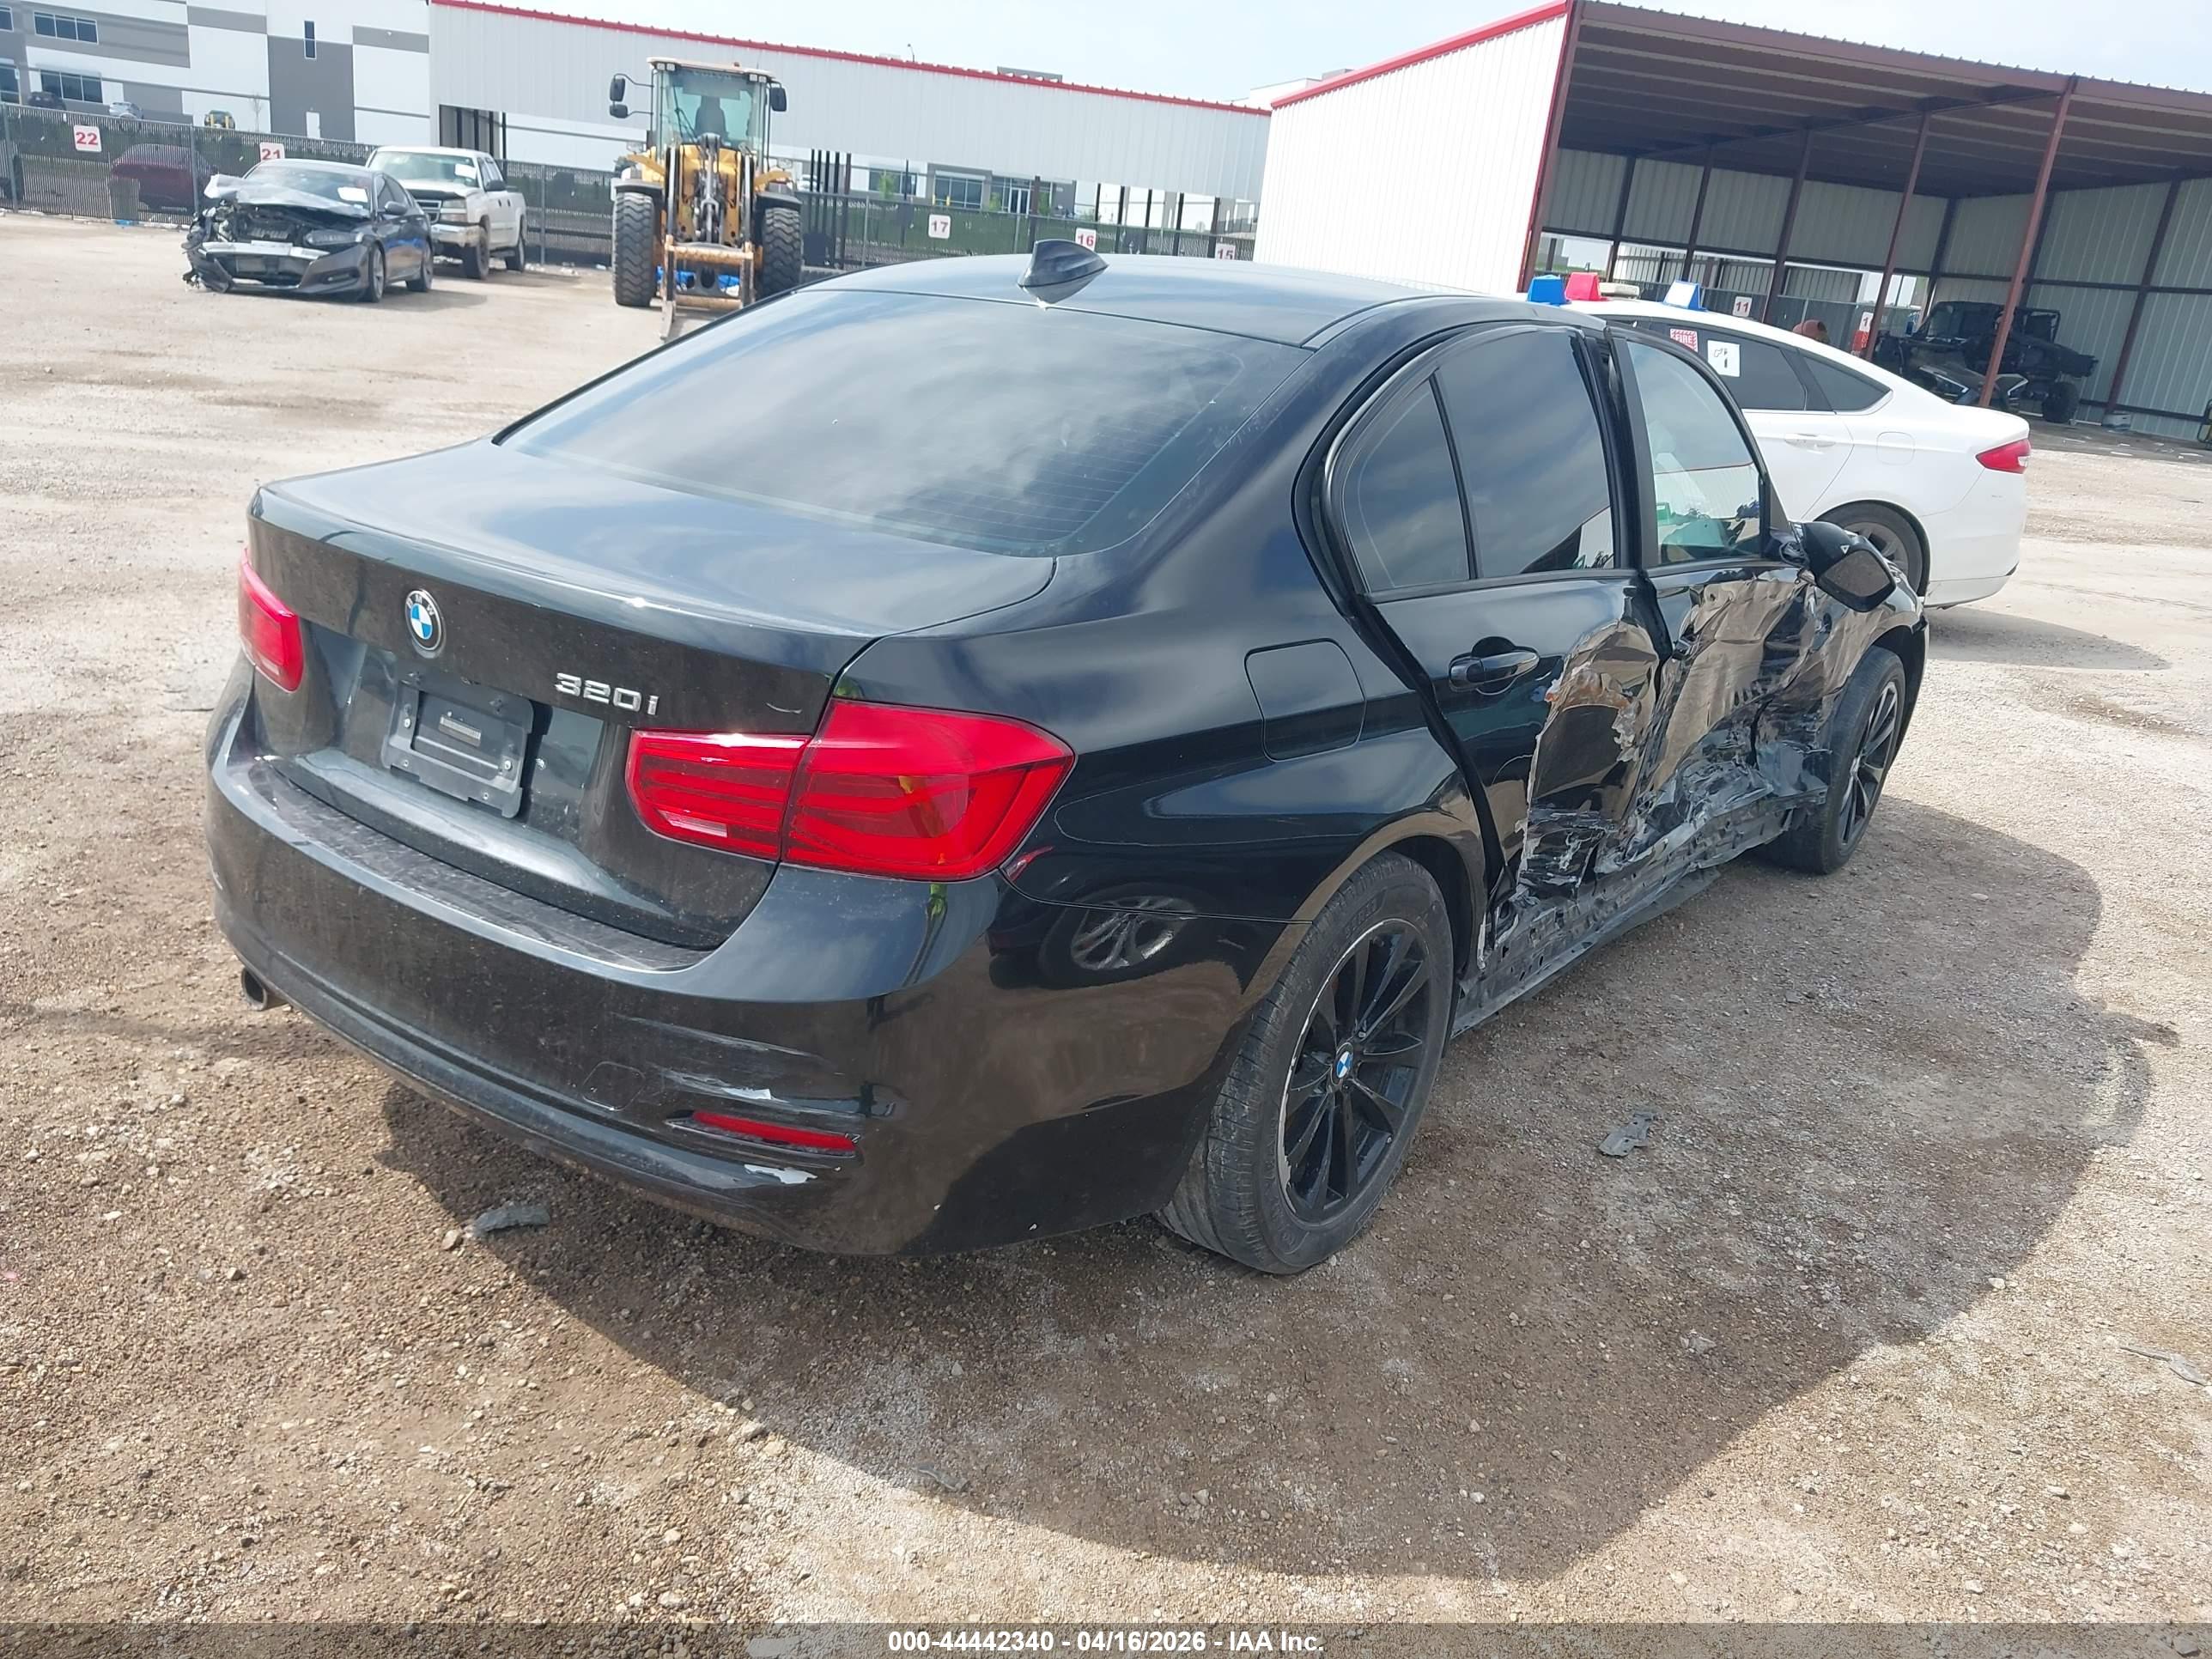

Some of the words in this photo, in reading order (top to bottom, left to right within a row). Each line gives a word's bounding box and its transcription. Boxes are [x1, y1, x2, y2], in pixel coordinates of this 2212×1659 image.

[76, 131, 98, 145] 22
[262, 149, 281, 161] 21
[931, 220, 949, 233] 17
[1078, 234, 1094, 246] 16
[1218, 249, 1234, 259] 15
[1735, 301, 1749, 313] 11
[1674, 333, 1693, 344] FIRE
[555, 672, 659, 715] 320i
